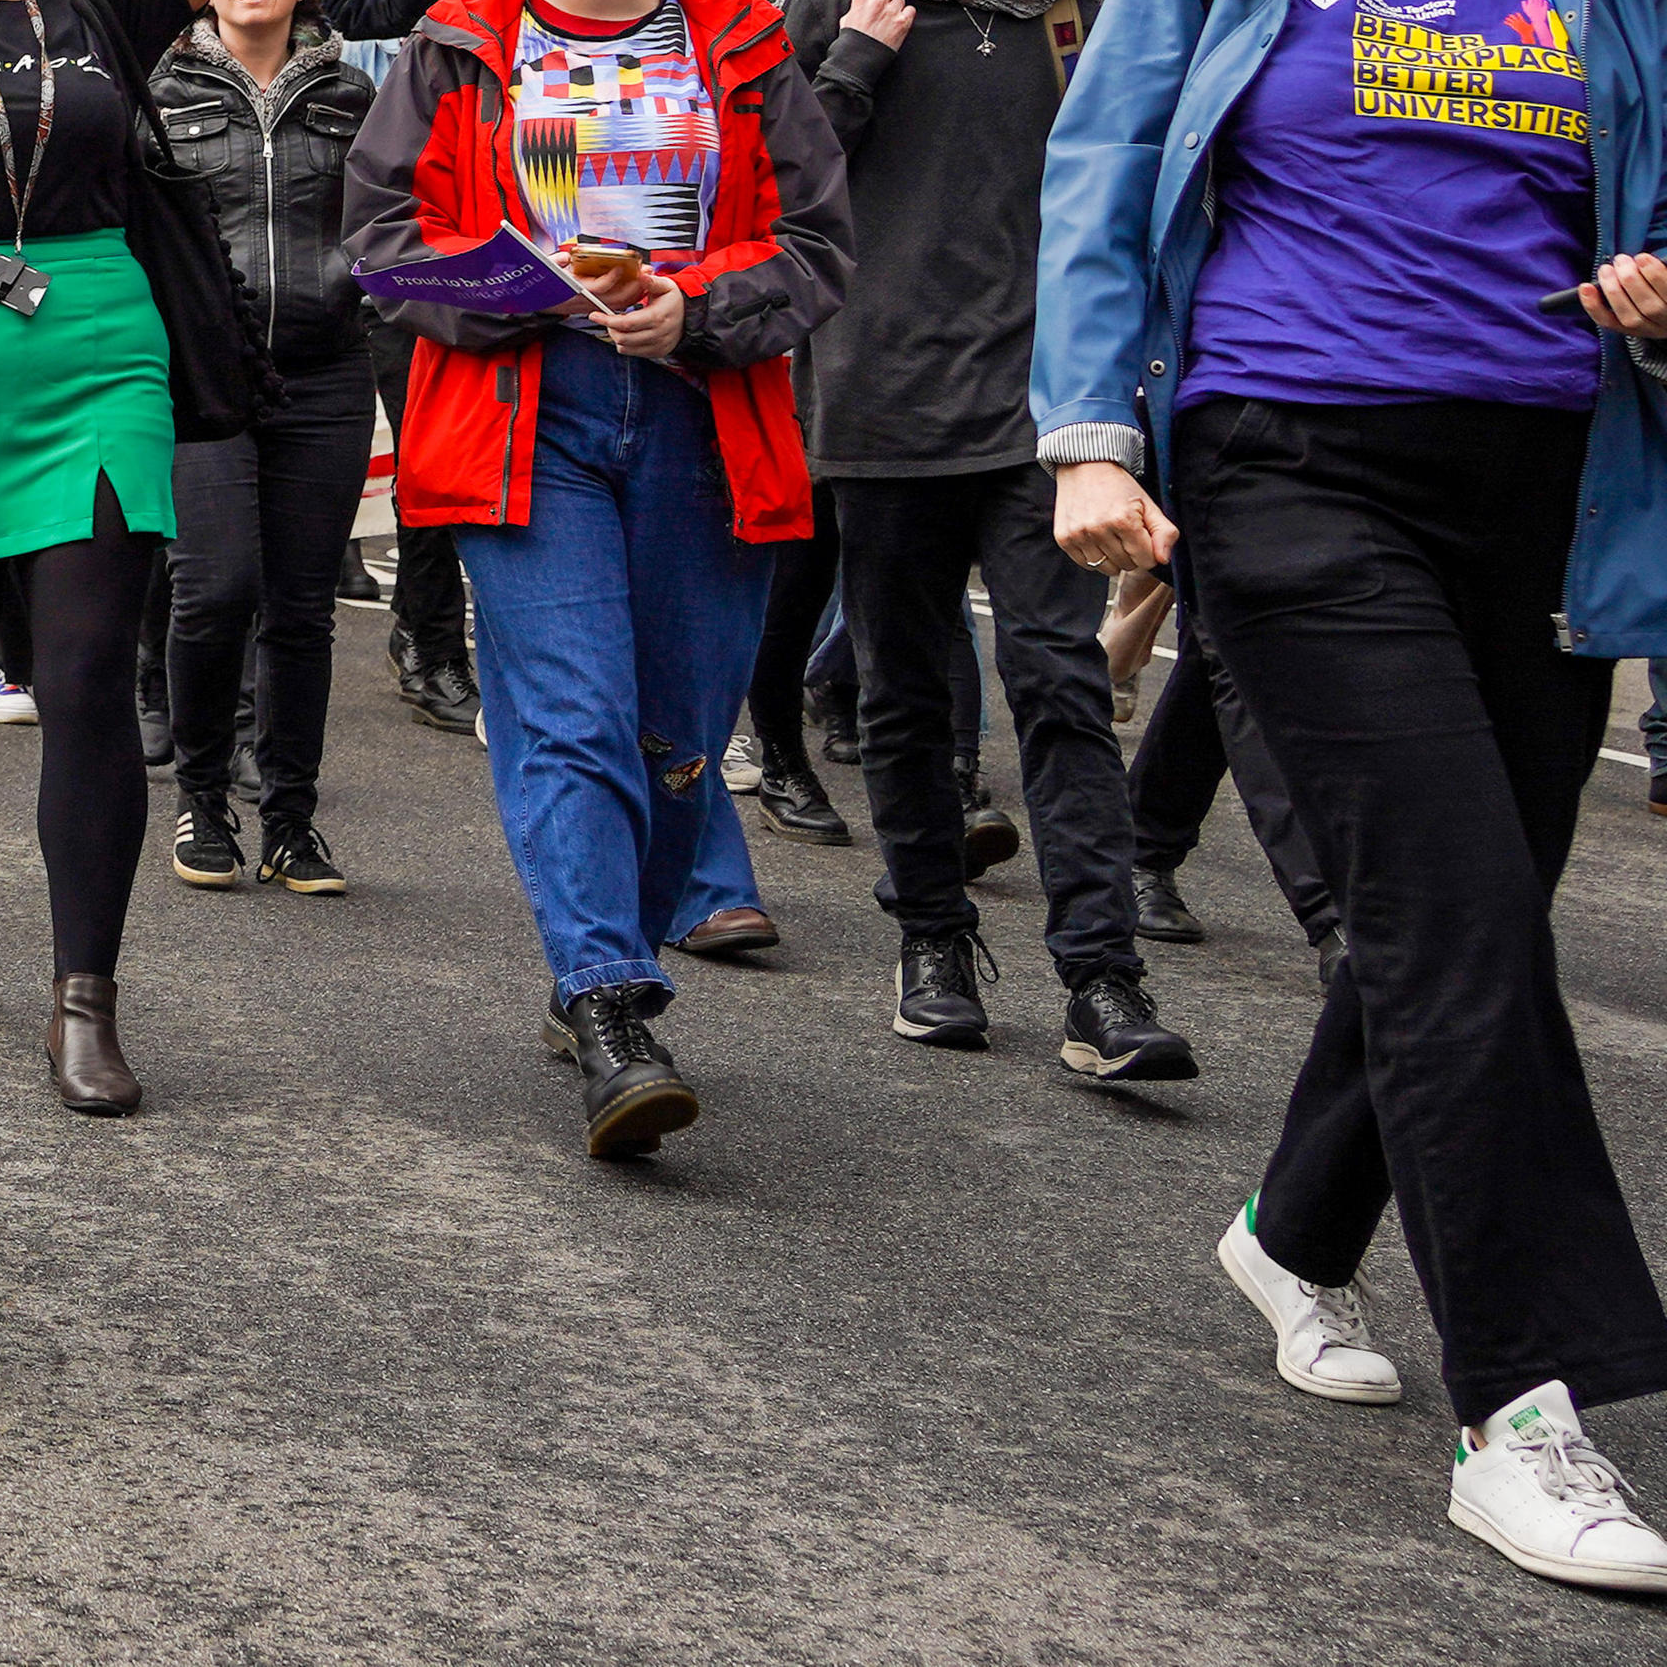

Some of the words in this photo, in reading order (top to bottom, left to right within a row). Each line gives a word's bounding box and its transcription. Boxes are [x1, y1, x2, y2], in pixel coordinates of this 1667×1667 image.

[1357, 16, 1483, 50] BETTER
[1358, 64, 1487, 95] BETTER
[1358, 92, 1587, 143] UNIVERSITIES
[392, 275, 442, 287] Proud
[444, 278, 460, 288] to
[462, 278, 483, 289] be
[484, 263, 535, 286] union
